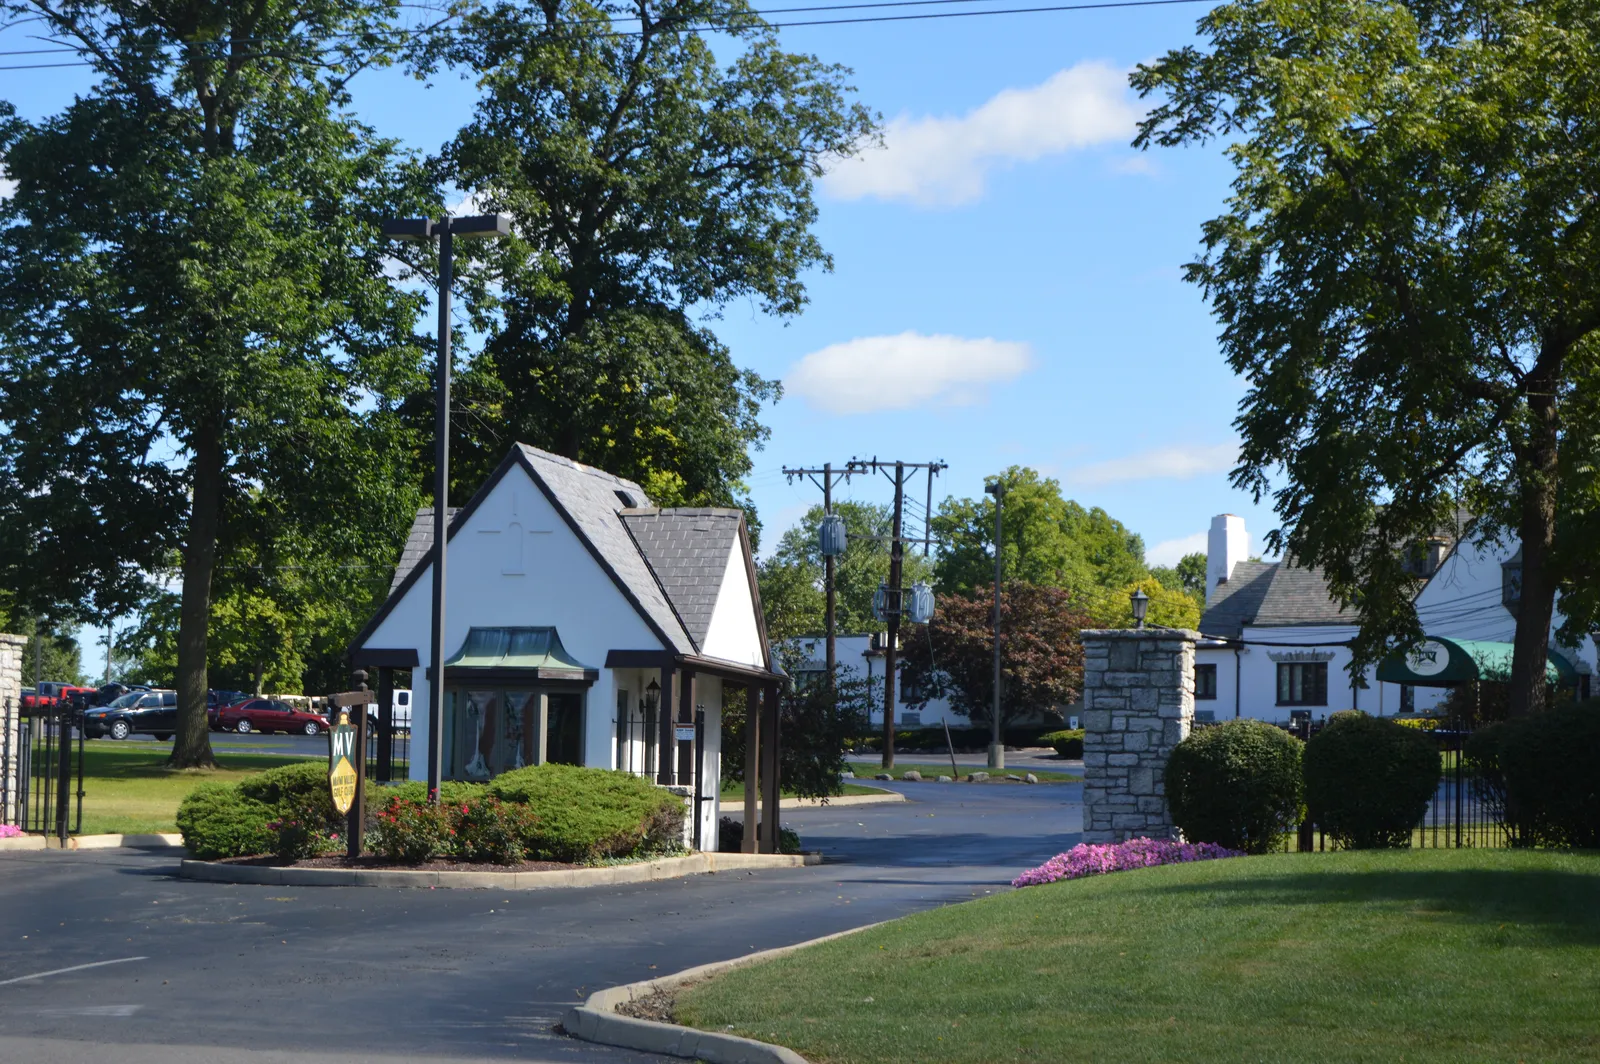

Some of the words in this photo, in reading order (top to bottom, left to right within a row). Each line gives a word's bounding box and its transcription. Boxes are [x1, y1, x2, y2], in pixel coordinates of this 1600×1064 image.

[333, 732, 354, 757] MV
[333, 787, 344, 797] GOLF
[344, 786, 354, 796] CLUB
